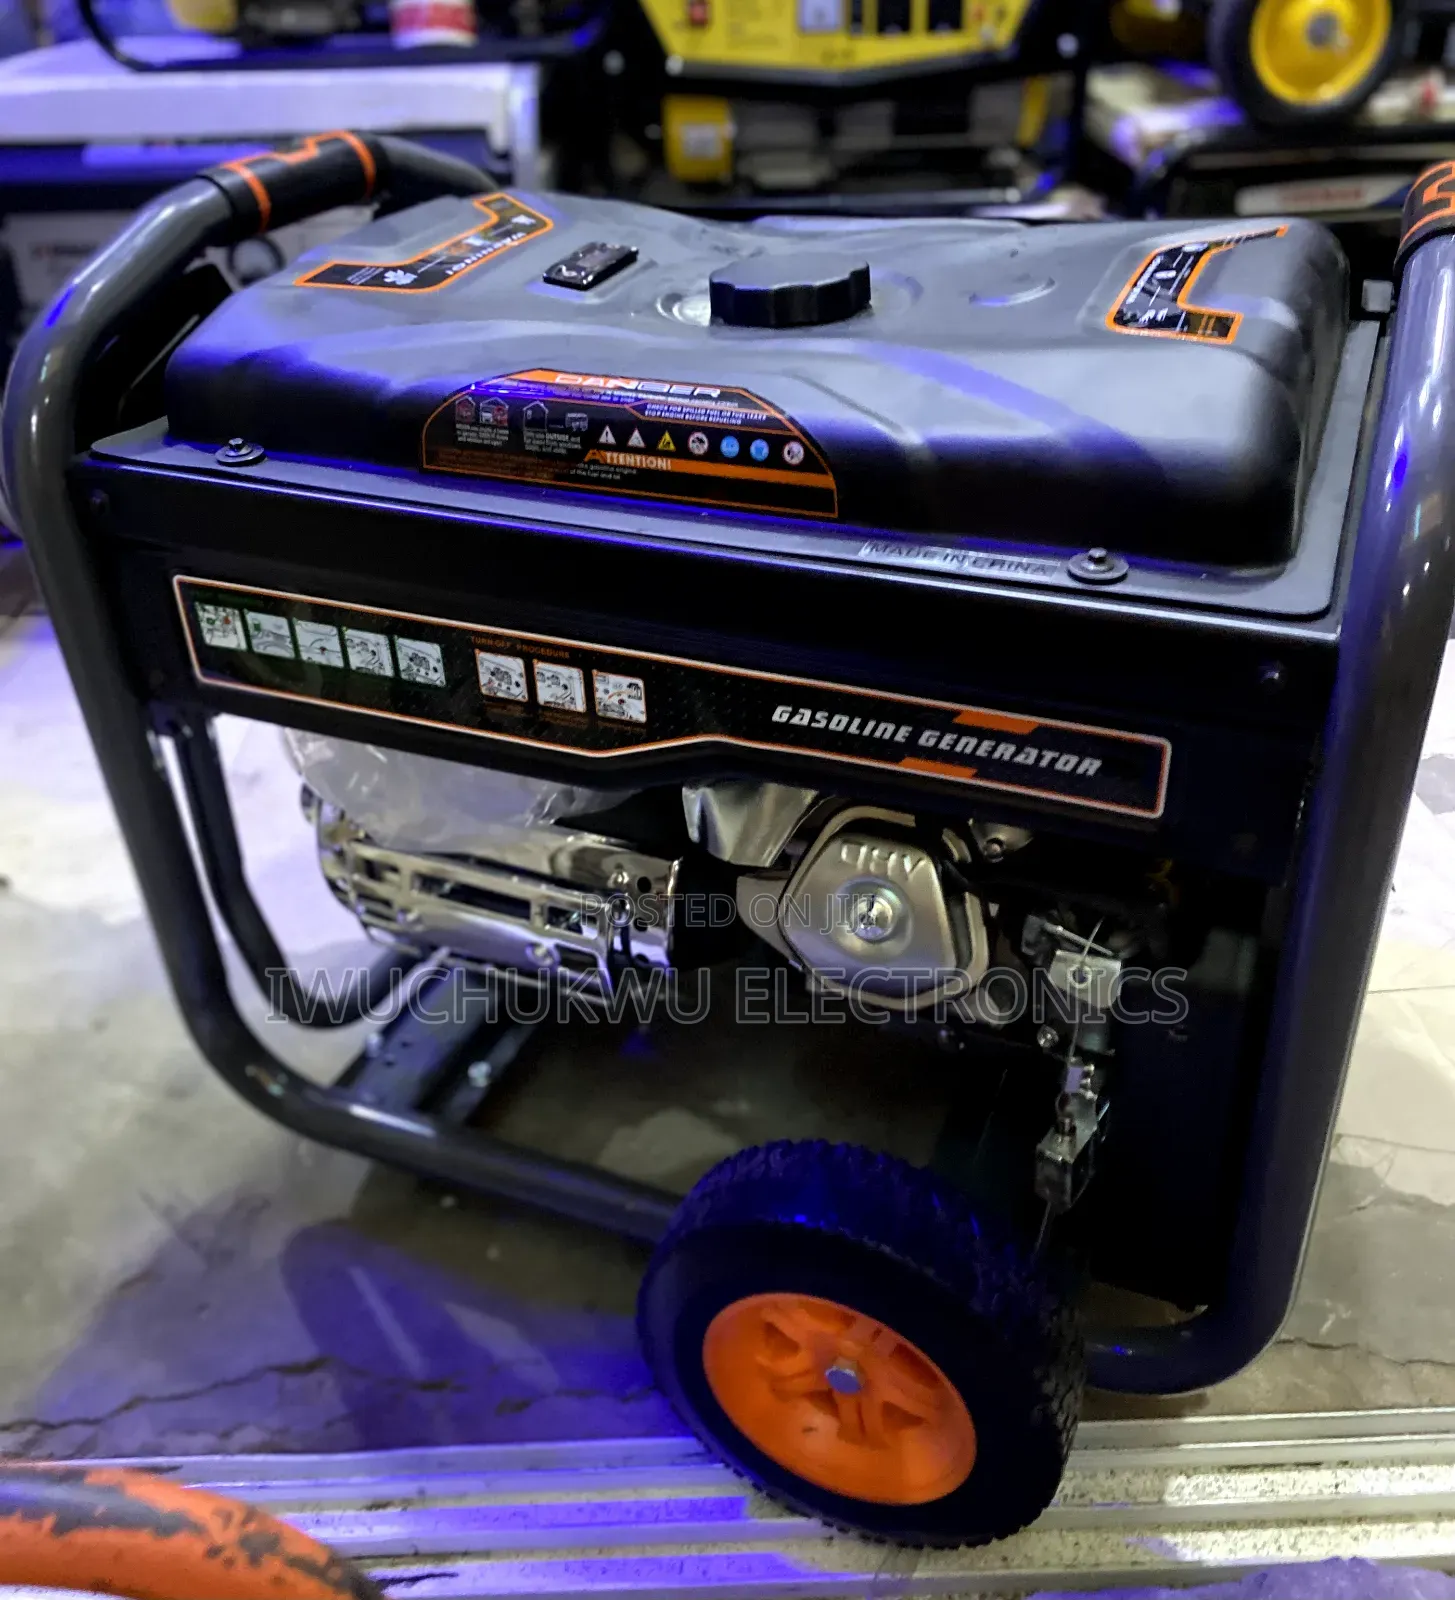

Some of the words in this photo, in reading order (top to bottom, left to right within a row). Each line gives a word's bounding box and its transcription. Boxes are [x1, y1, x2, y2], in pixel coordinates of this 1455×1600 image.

[661, 412, 684, 420] ENGINE
[685, 414, 707, 422] BEFORE
[708, 416, 741, 425] REFUELING
[683, 407, 706, 415] SPILLED
[707, 409, 720, 417] FUEL
[942, 551, 966, 564] IN
[972, 557, 1048, 575] CHINA
[771, 705, 913, 743] GASOLINE
[918, 729, 1103, 777] GENERATOR
